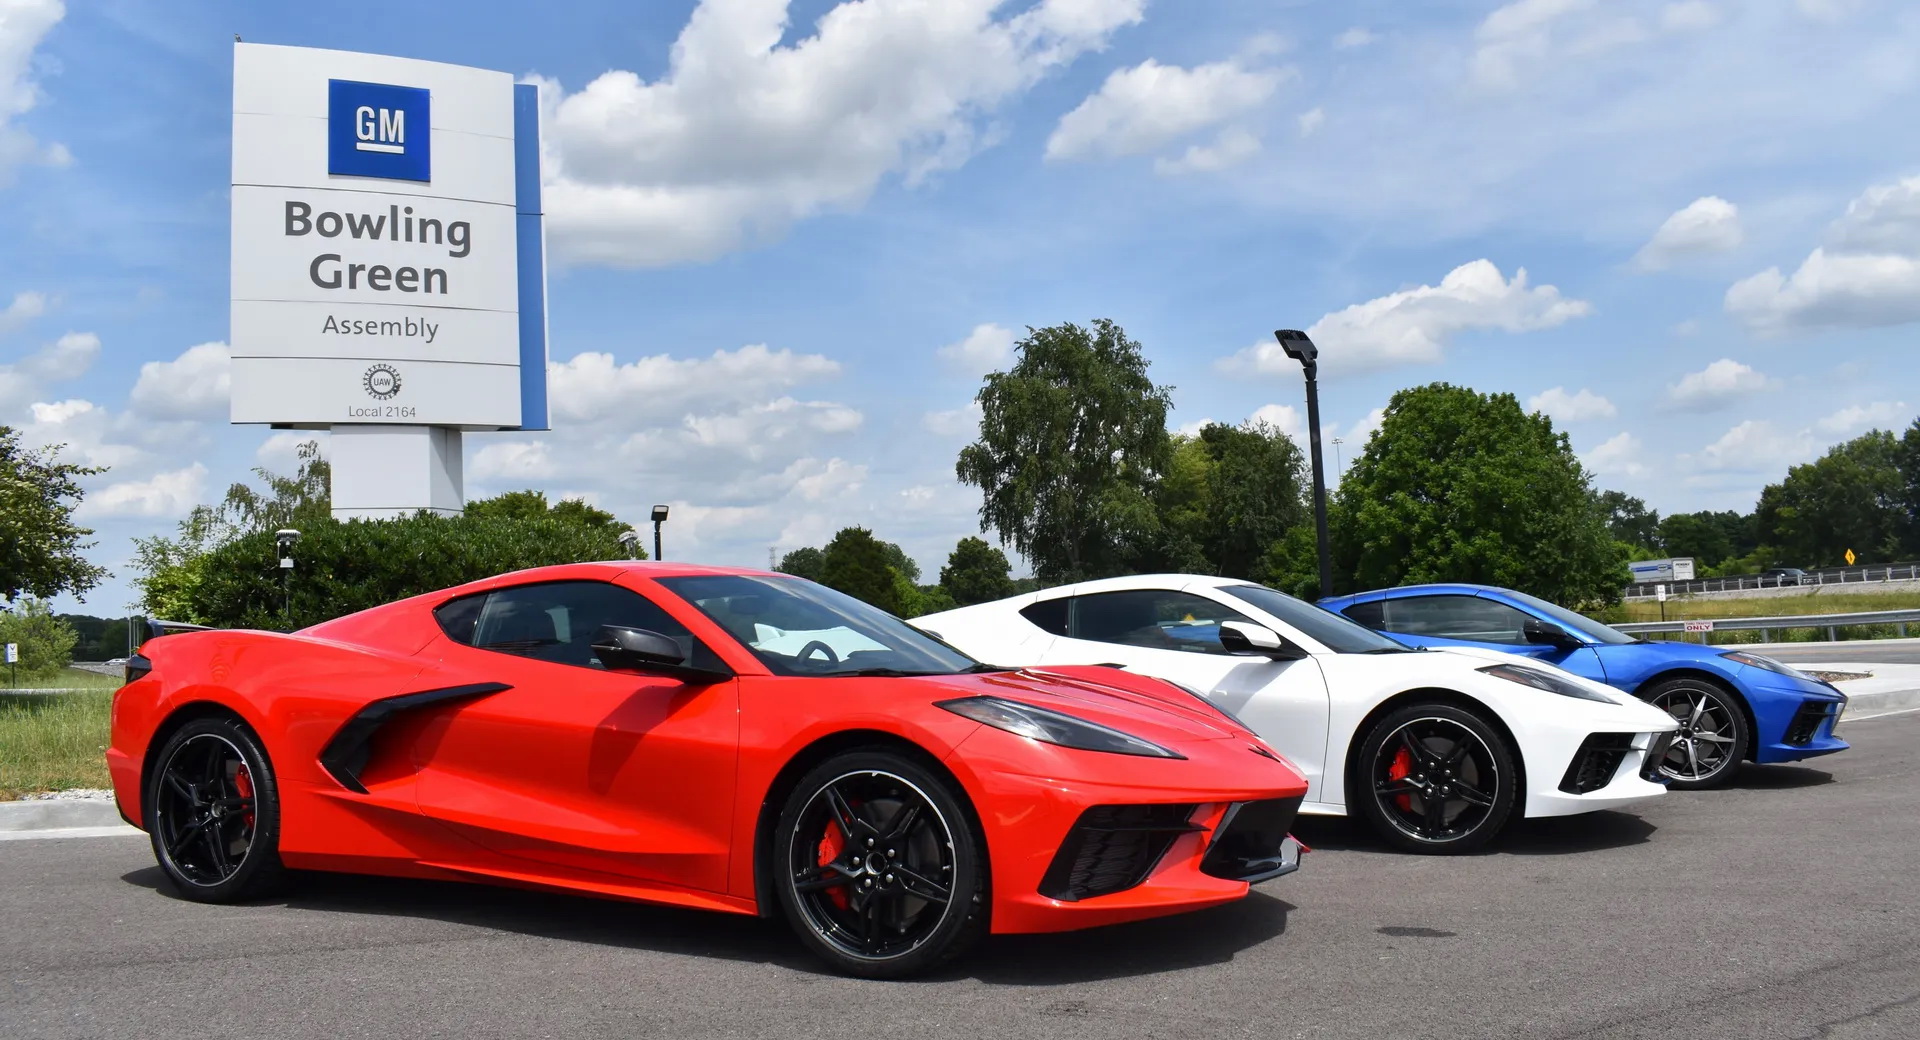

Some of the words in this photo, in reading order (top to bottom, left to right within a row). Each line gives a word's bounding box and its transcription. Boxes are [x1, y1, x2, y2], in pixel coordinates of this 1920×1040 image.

[356, 105, 405, 144] GM
[285, 200, 471, 258] Bowling
[309, 253, 448, 295] Green
[322, 315, 439, 344] Assembly
[373, 377, 392, 387] UAW
[348, 405, 382, 418] Local
[385, 406, 416, 418] 2164
